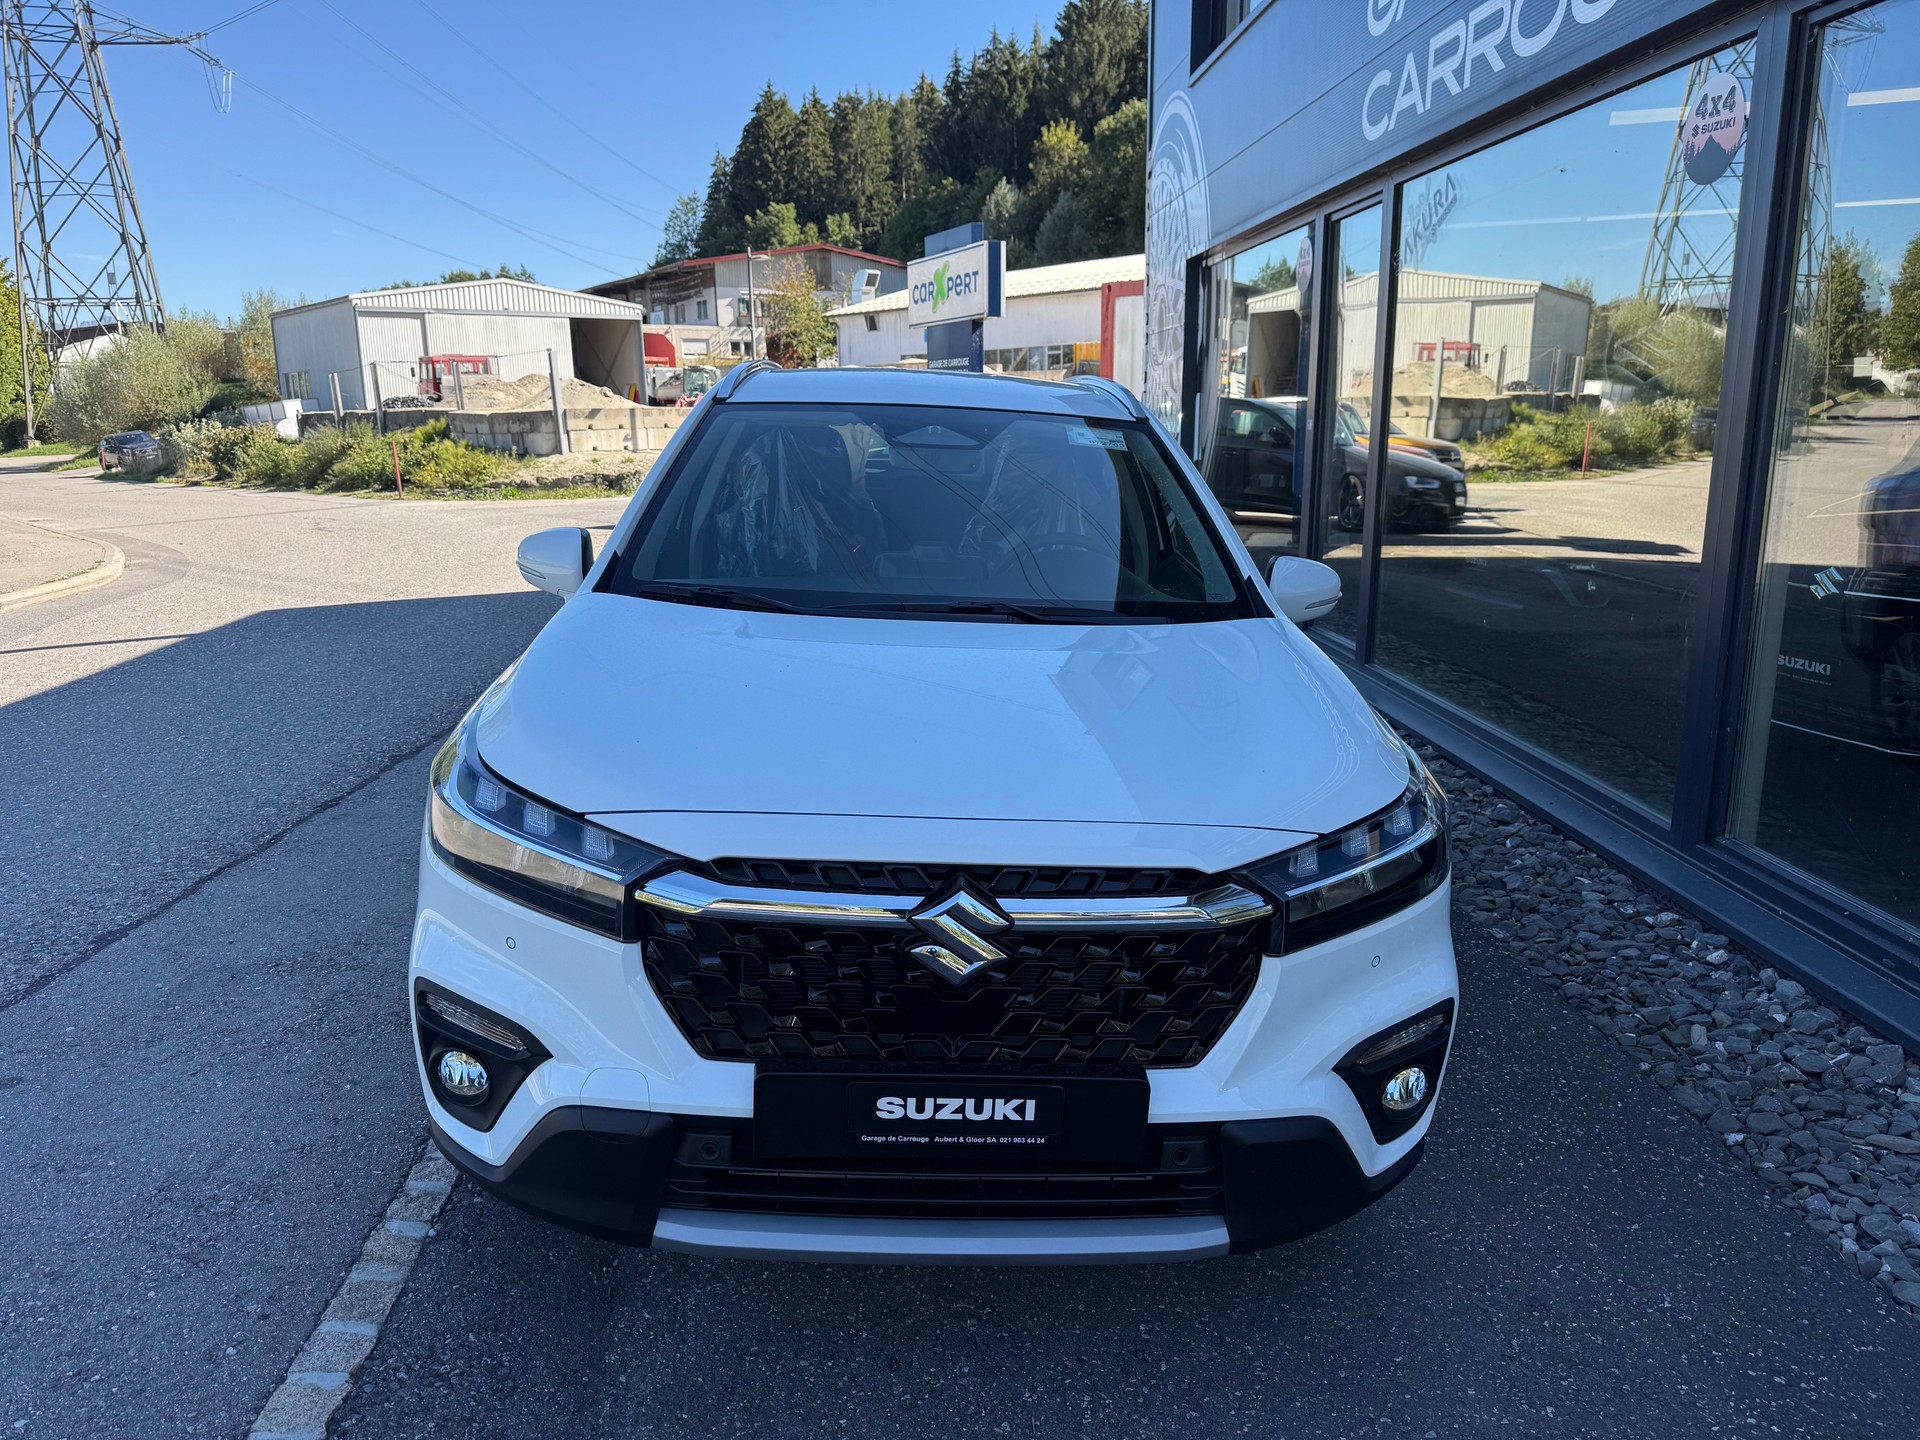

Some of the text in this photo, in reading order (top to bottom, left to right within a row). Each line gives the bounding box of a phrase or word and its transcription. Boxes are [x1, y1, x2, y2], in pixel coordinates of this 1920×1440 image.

[1701, 116, 1736, 134] SUZUKI
[1778, 654, 1831, 676] SUZUKI
[876, 1096, 1036, 1121] SUZUKI
[861, 1135, 886, 1143] Garage
[898, 1135, 930, 1143] Carrouge
